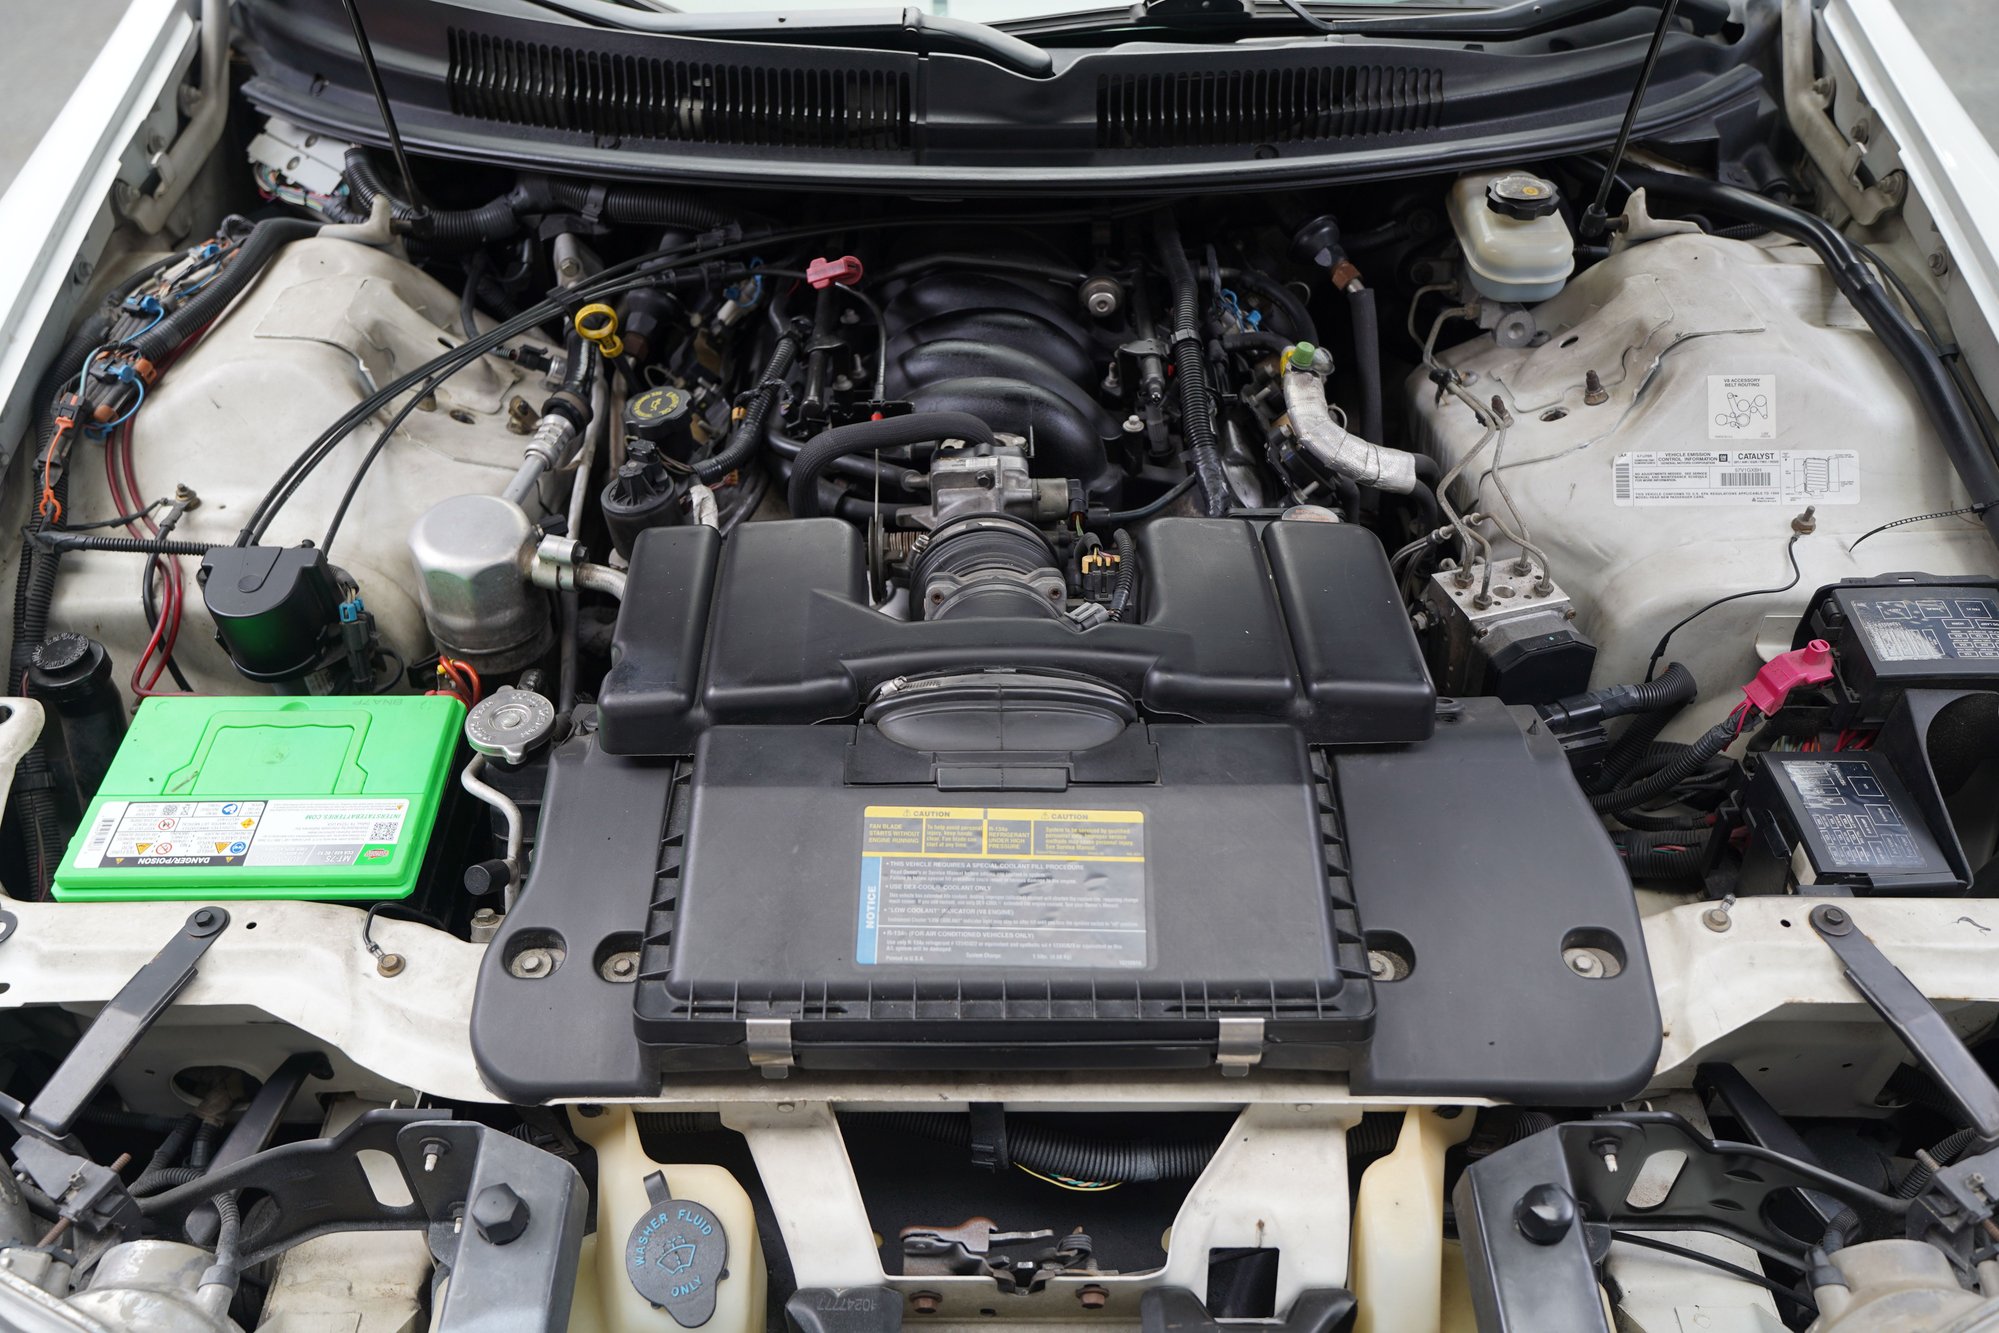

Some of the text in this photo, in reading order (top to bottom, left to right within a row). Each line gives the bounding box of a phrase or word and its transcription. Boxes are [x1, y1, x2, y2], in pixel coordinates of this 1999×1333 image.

[1737, 452, 1775, 460] CATALYST
[913, 810, 951, 818] CAUTION
[137, 856, 211, 865] DANGER/POISON
[325, 855, 352, 863] MT-75
[866, 884, 877, 929] NOTICE
[634, 1208, 714, 1267] WASHER FLUID
[671, 1274, 705, 1298] ONLY
[816, 1297, 878, 1311] 10247777
